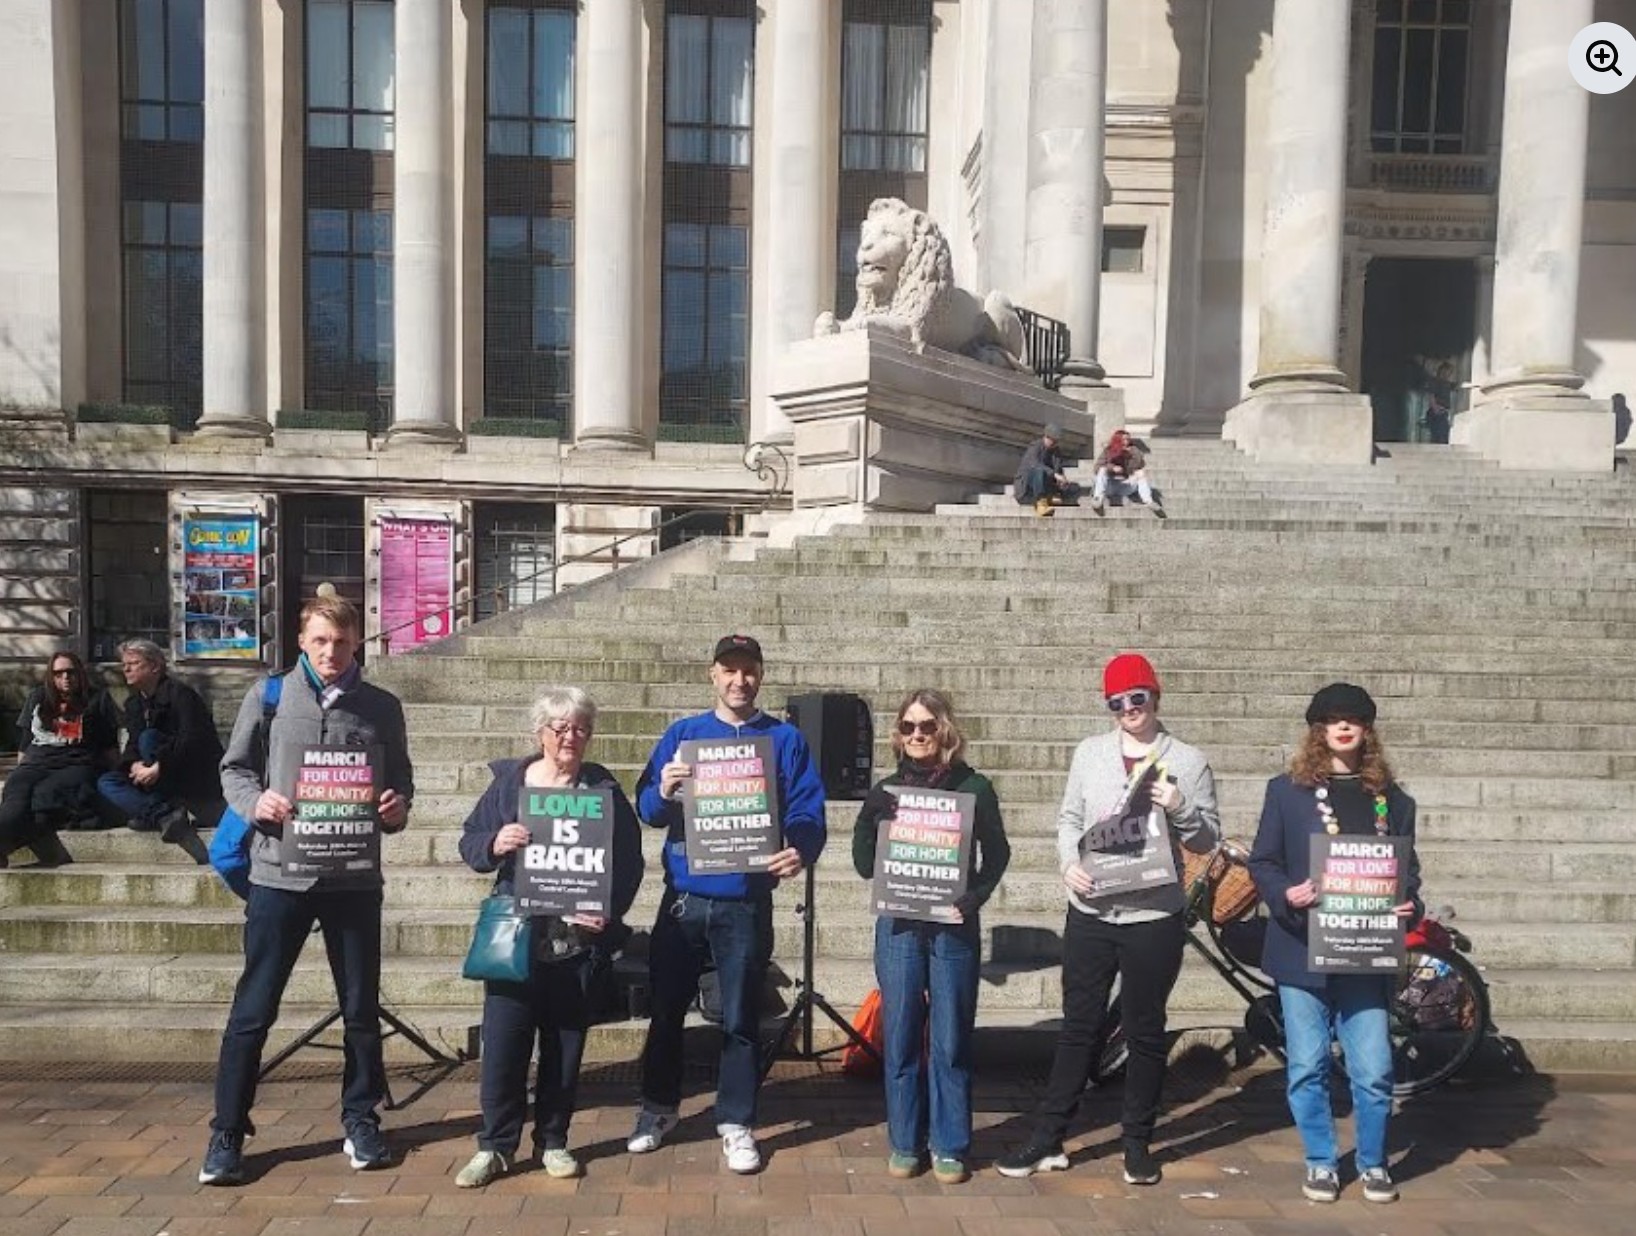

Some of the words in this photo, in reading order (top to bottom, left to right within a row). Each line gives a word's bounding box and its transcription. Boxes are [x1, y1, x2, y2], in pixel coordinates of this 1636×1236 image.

[304, 751, 367, 766] MARCH
[698, 744, 756, 761] MARCH
[303, 770, 329, 782] FOR
[333, 769, 369, 782] LOVE.
[701, 766, 725, 779] FOR
[727, 763, 760, 776] LOVE.
[300, 785, 325, 799] FOR
[698, 780, 721, 793] FOR
[302, 803, 326, 817] FOR
[331, 804, 368, 817] HOPE.
[529, 794, 603, 818] LOVE
[701, 800, 724, 814] FOR
[726, 796, 764, 811] HOPE.
[898, 794, 956, 811] MARCH
[693, 814, 772, 832] TOGETHER
[899, 811, 921, 824] FOR
[292, 821, 373, 834] TOGETHER
[553, 818, 580, 844] IS
[891, 824, 916, 839] FOR
[1085, 811, 1161, 851] BACK
[894, 844, 917, 859] FOR
[1330, 843, 1394, 857] MARCH
[524, 844, 605, 873] BACK
[883, 860, 960, 880] TOGETHER
[1330, 862, 1356, 874] FOR
[1326, 878, 1351, 891] FOR
[1329, 896, 1353, 910] FOR
[1318, 913, 1399, 929] TOGETHER
